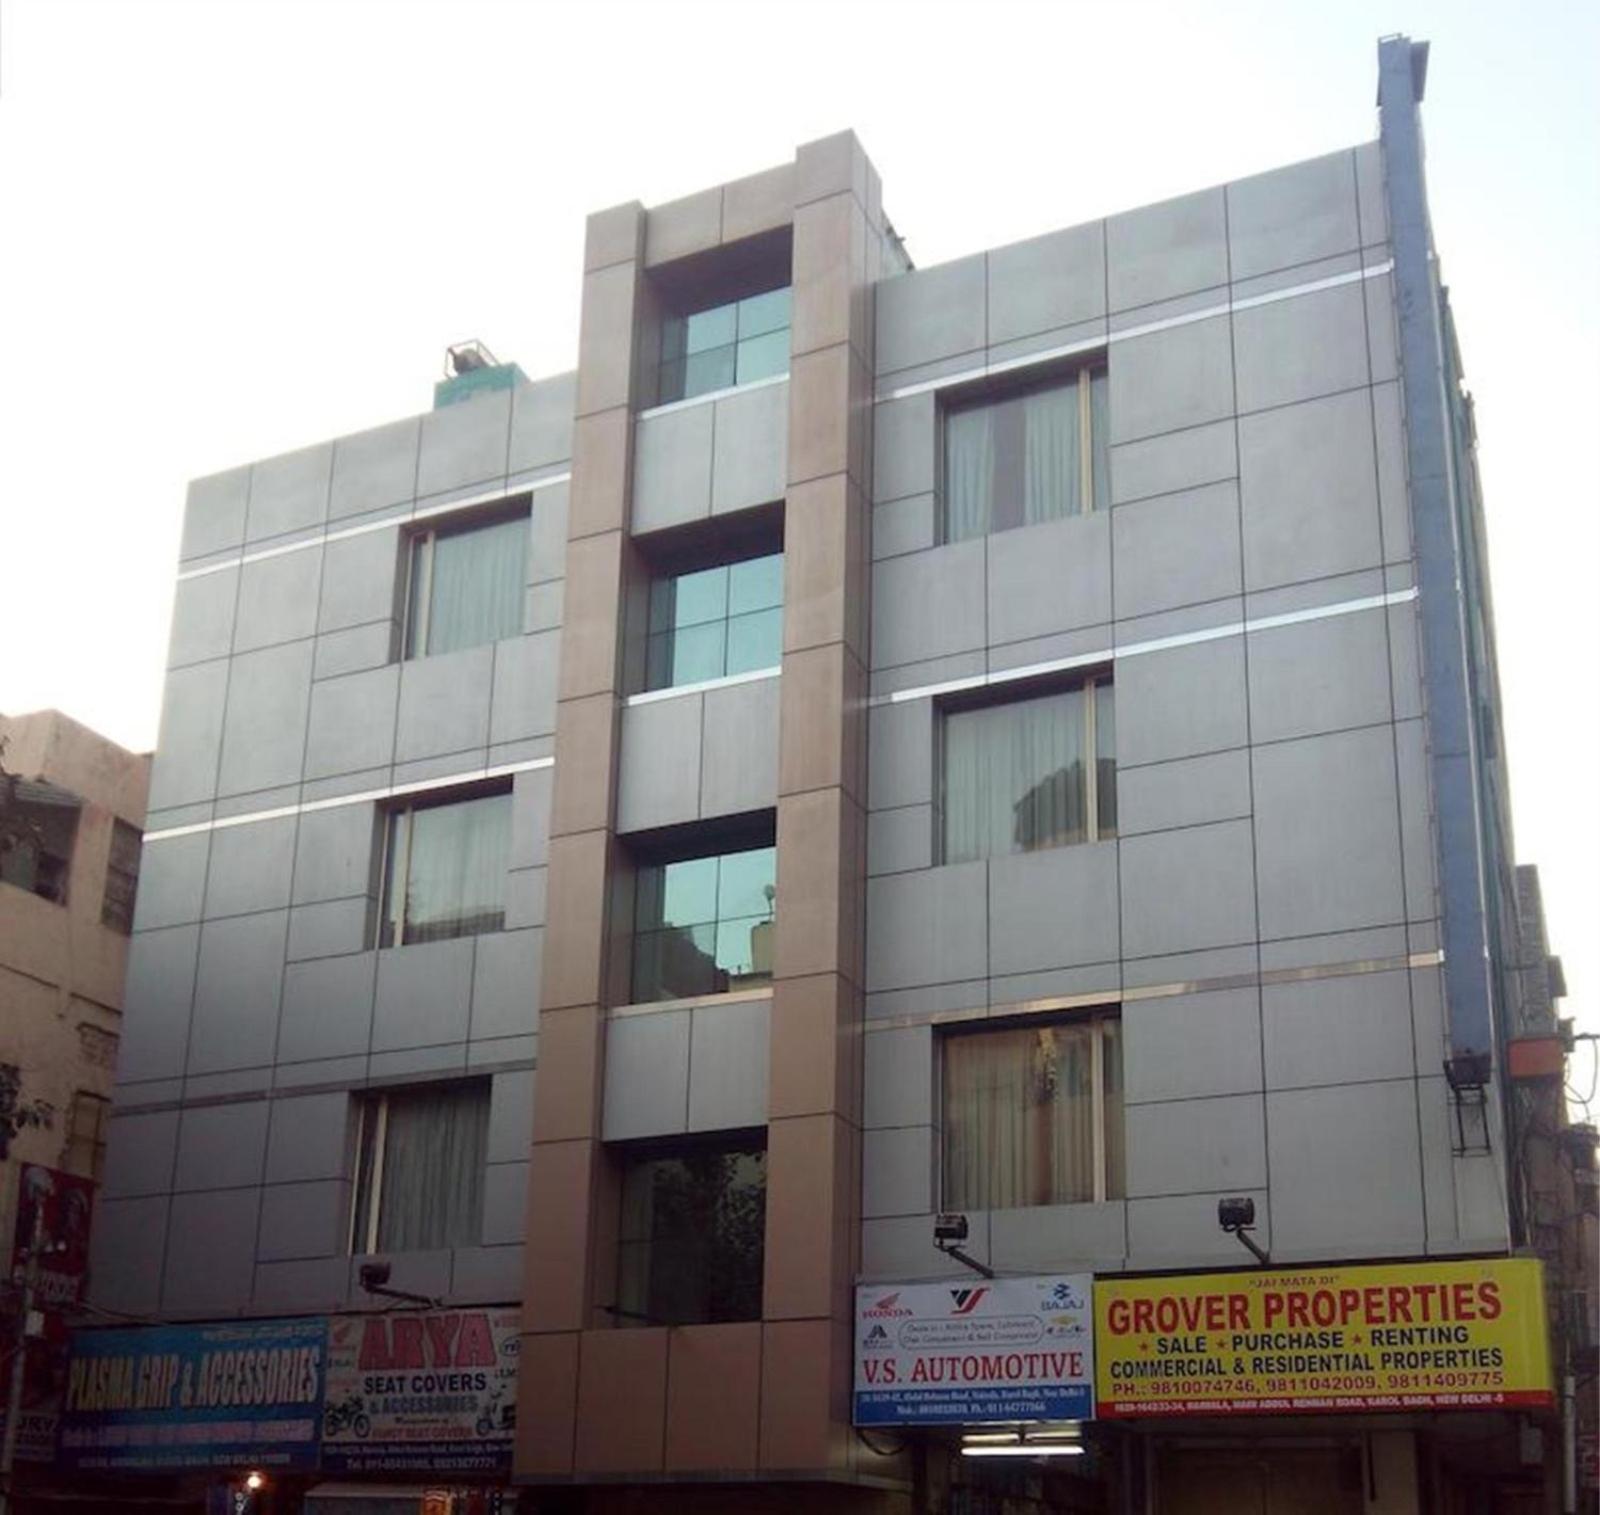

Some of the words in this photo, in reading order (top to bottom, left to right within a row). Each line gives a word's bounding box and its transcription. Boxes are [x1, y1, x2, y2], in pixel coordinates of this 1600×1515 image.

[1108, 1293, 1252, 1335] GROVER
[1263, 1281, 1502, 1329] PROPERTIES
[358, 1313, 497, 1371] ARYA
[1157, 1336, 1208, 1354] SALE
[1232, 1331, 1344, 1352] PURCHASE
[1371, 1325, 1470, 1346] RENTING
[65, 1355, 134, 1412] PLASMA
[133, 1354, 180, 1408] GRIP
[194, 1346, 320, 1406] ACCESSORIES
[863, 1357, 902, 1384] V.S.
[911, 1351, 1083, 1383] AUTOMOTIVE
[1110, 1358, 1226, 1379] COMMERCIAL
[1233, 1357, 1244, 1375] &
[1252, 1353, 1375, 1375] RESIDENTIAL
[1381, 1347, 1503, 1370] PROPERTIES
[364, 1375, 406, 1395] SEAT
[411, 1373, 487, 1394] COVERS
[1151, 1379, 1261, 1395] 9810074746,
[1267, 1375, 1382, 1392] 9811042009,
[1387, 1371, 1504, 1388] 9811409775
